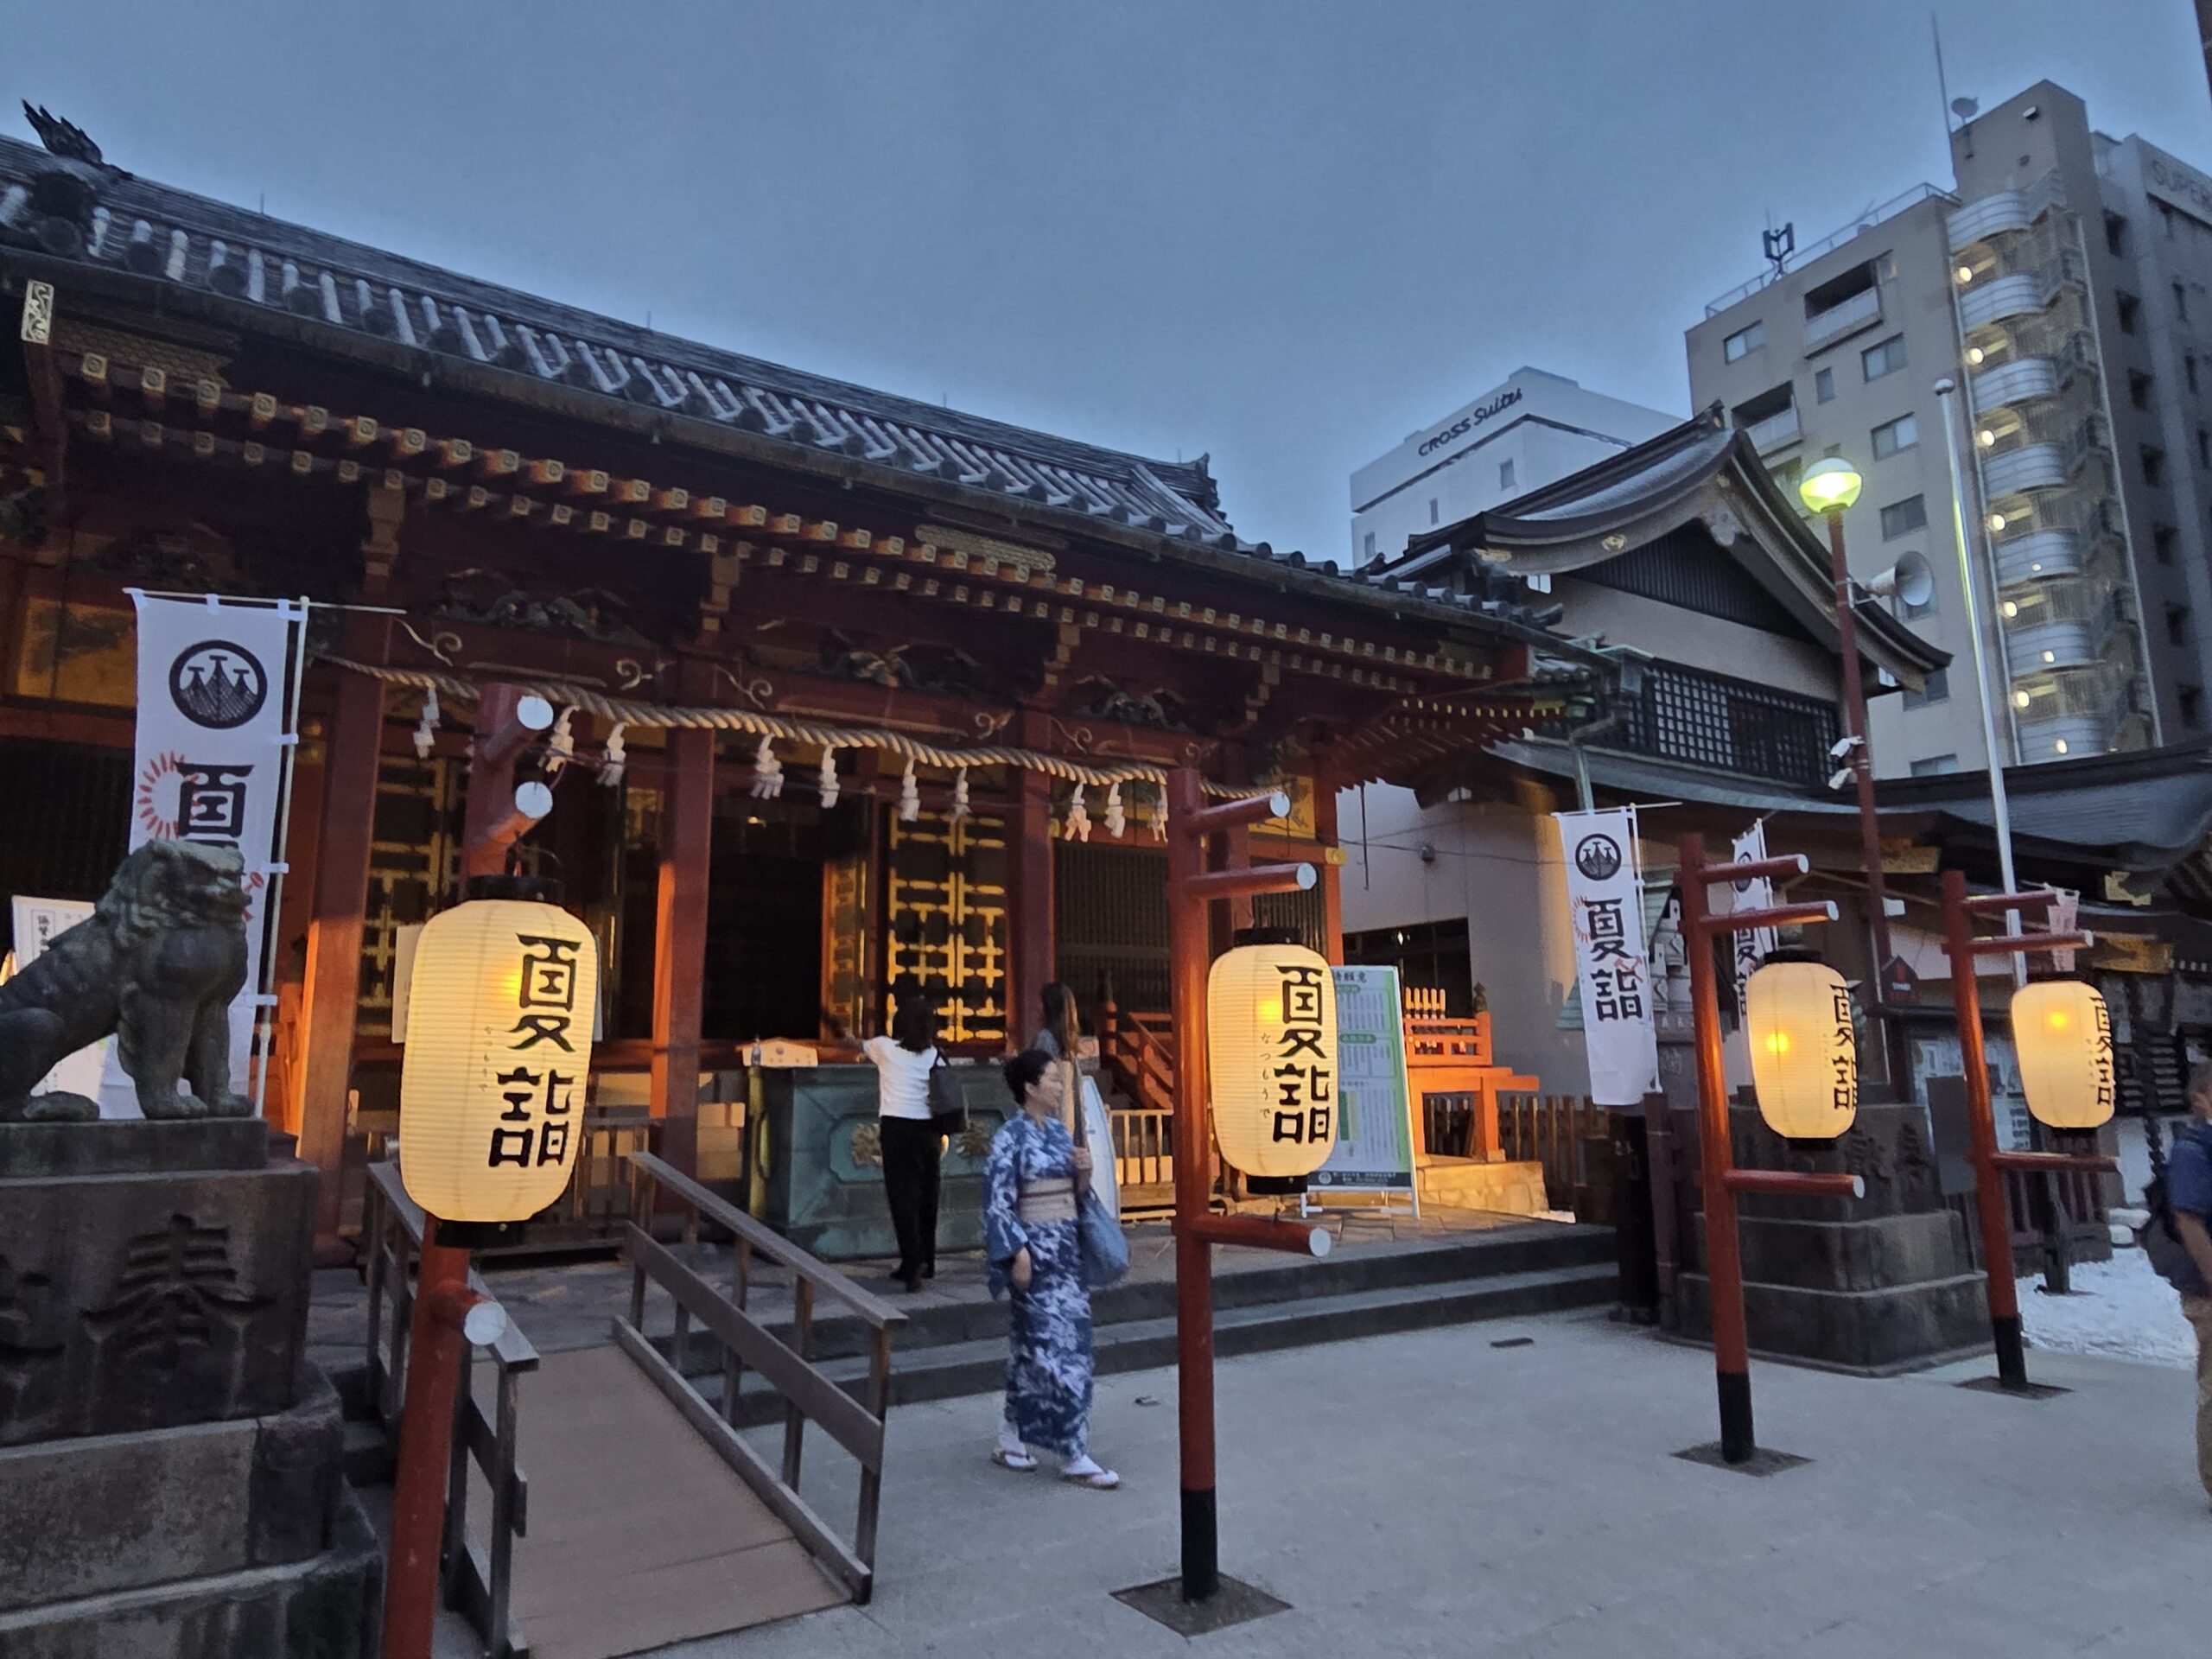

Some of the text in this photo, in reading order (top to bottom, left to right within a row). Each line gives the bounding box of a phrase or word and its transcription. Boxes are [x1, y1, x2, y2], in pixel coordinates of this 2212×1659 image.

[1418, 417, 1471, 456] CROSS
[1584, 898, 1643, 1022] 夏詣
[486, 931, 582, 1168] 夏詣
[1273, 964, 1331, 1145] 夏詣
